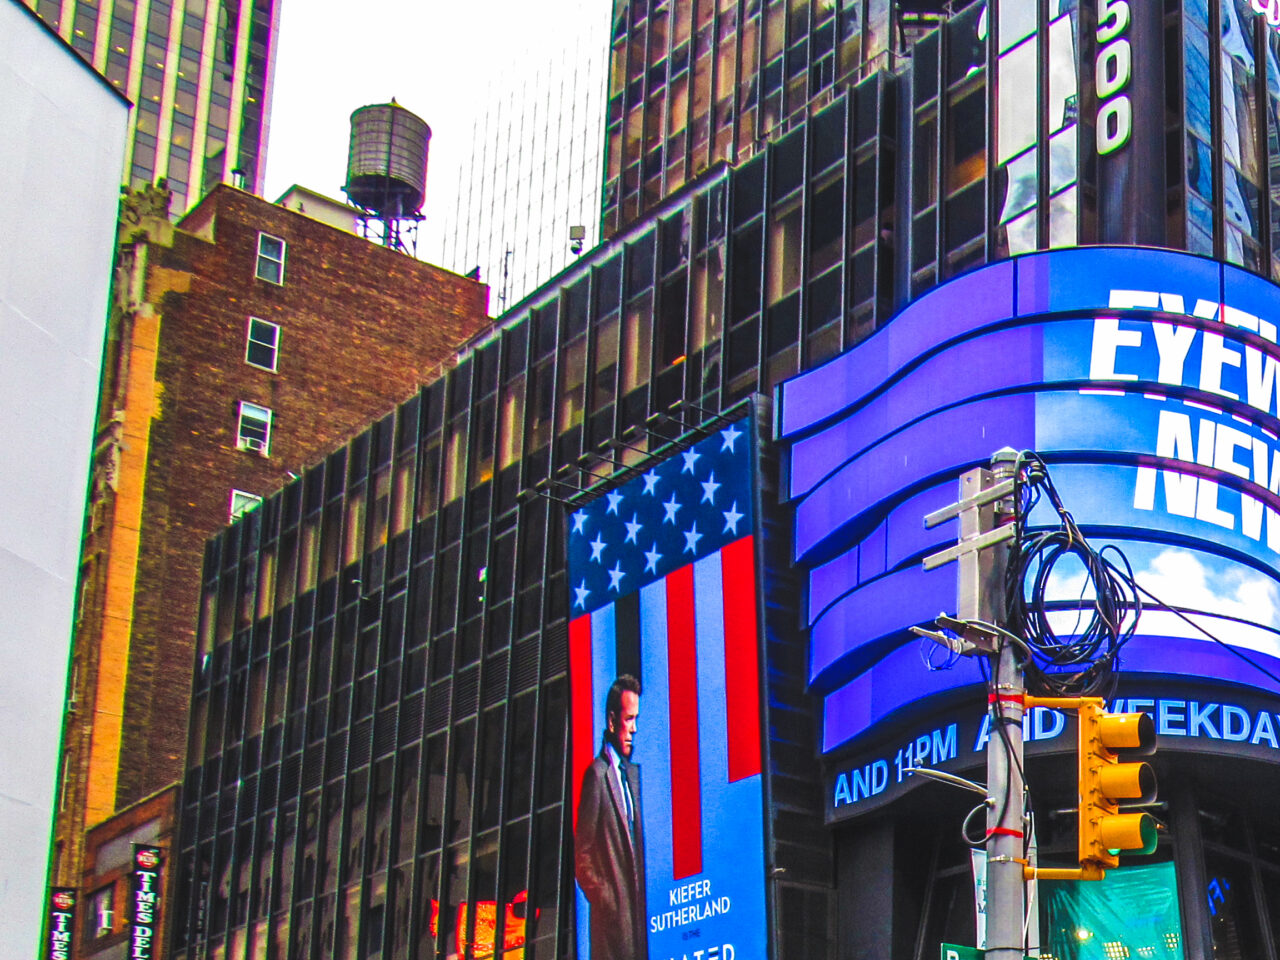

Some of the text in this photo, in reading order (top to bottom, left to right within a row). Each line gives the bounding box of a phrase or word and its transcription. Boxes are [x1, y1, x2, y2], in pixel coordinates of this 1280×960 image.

[834, 762, 889, 808] AND
[894, 723, 958, 783] 11PM
[136, 871, 157, 924] TIMES
[650, 896, 731, 934] SUTHERLAND
[669, 879, 712, 907] KIEFER
